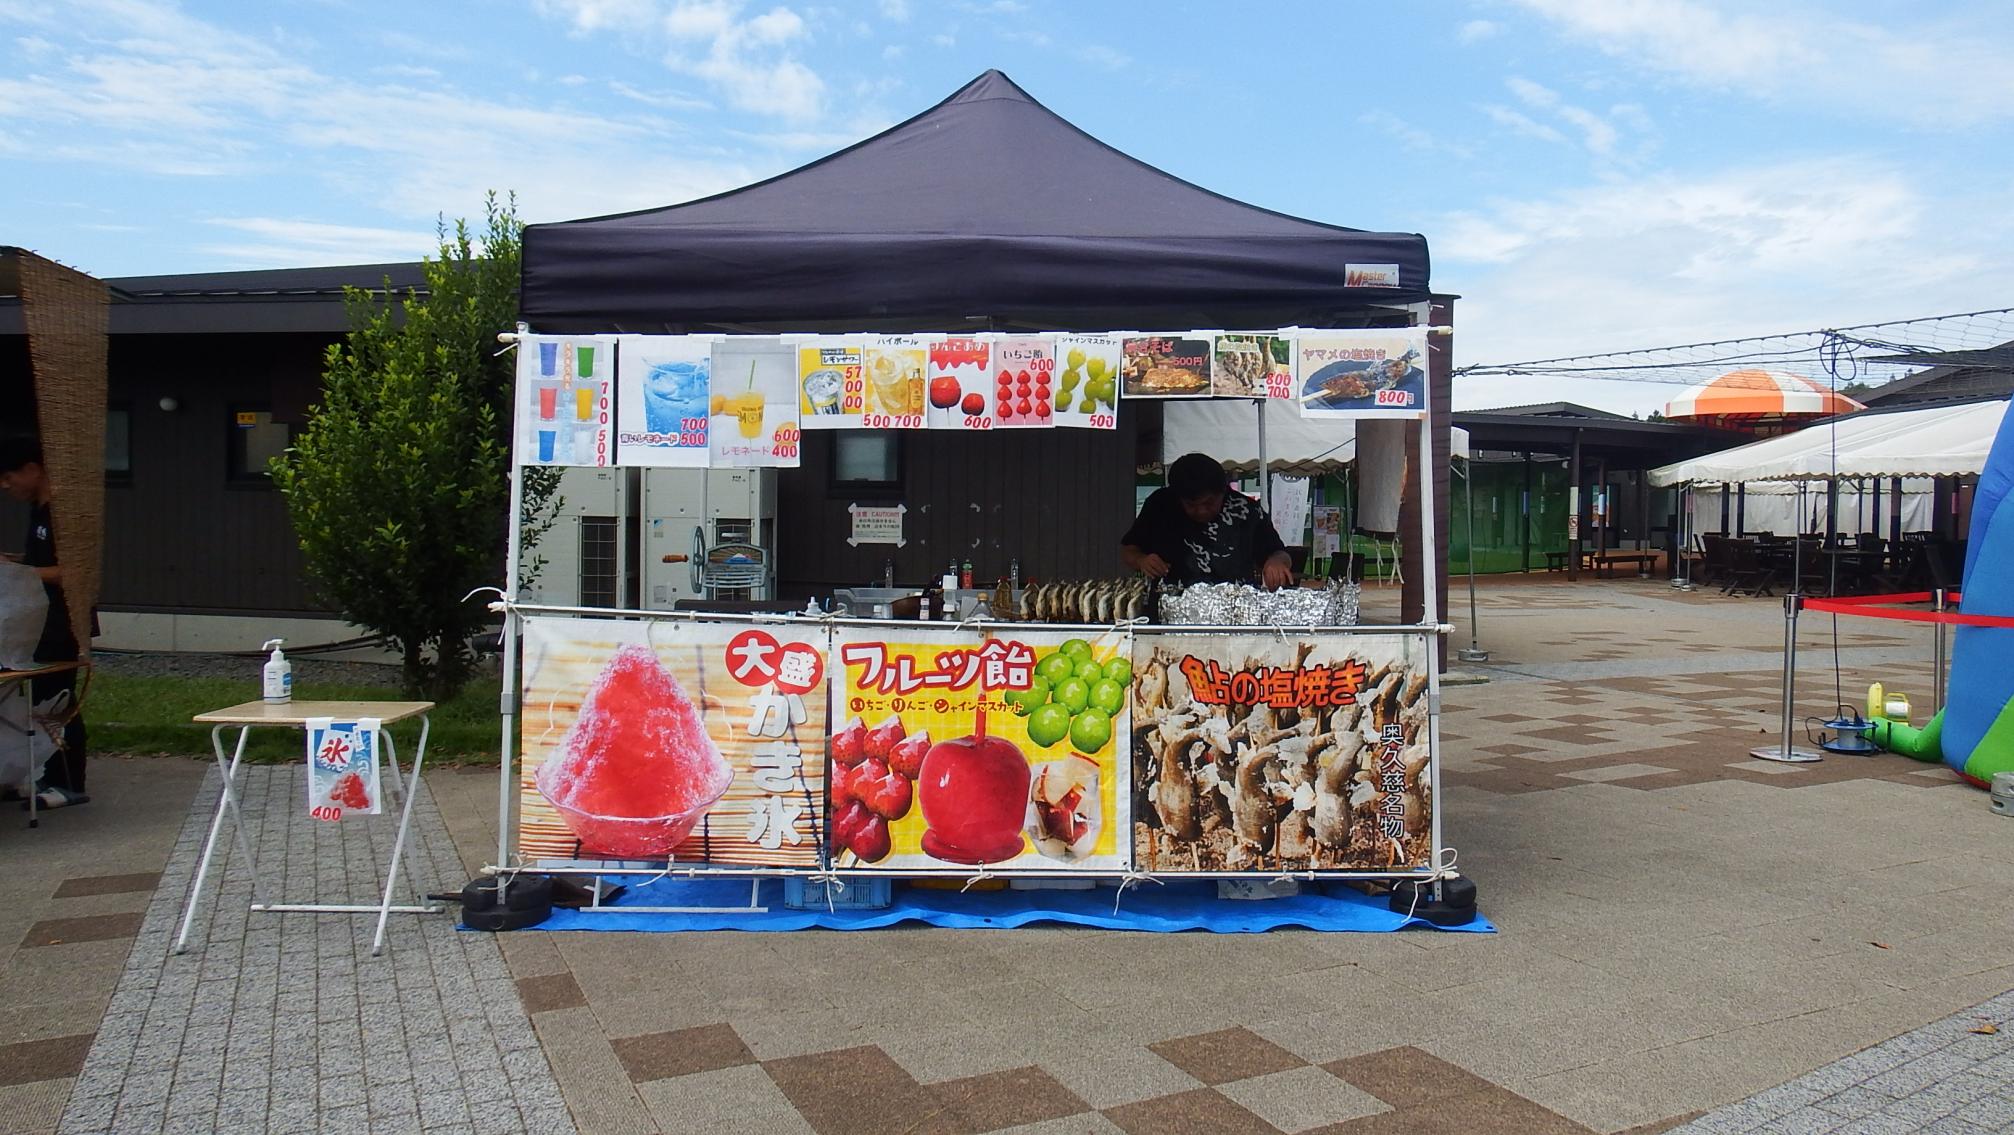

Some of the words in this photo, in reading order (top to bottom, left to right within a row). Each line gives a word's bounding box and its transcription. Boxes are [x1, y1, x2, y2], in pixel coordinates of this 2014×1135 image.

[1062, 337, 1117, 346] シャインマスカット
[1003, 349, 1043, 359] いちご飴
[1303, 348, 1386, 360] ヤマメの塩焼き
[1030, 359, 1054, 371] 600
[1266, 373, 1292, 386] 800
[1267, 386, 1290, 399] 700
[681, 418, 707, 431] 700
[863, 414, 890, 427] 500
[894, 415, 921, 427] 700
[964, 416, 991, 429] 600
[1089, 415, 1114, 427] 500
[680, 433, 706, 445] 500
[774, 430, 800, 442] 600
[722, 446, 769, 456] レモネード
[772, 445, 797, 457] 400
[732, 637, 816, 688] 大盛
[842, 639, 1036, 695] フルーツ飴
[1179, 654, 1367, 709] 鮎の塩焼き
[320, 737, 349, 764] 氷
[746, 683, 808, 850] かき氷
[1379, 722, 1406, 839] 奥久慈名物
[311, 806, 341, 821] 400
